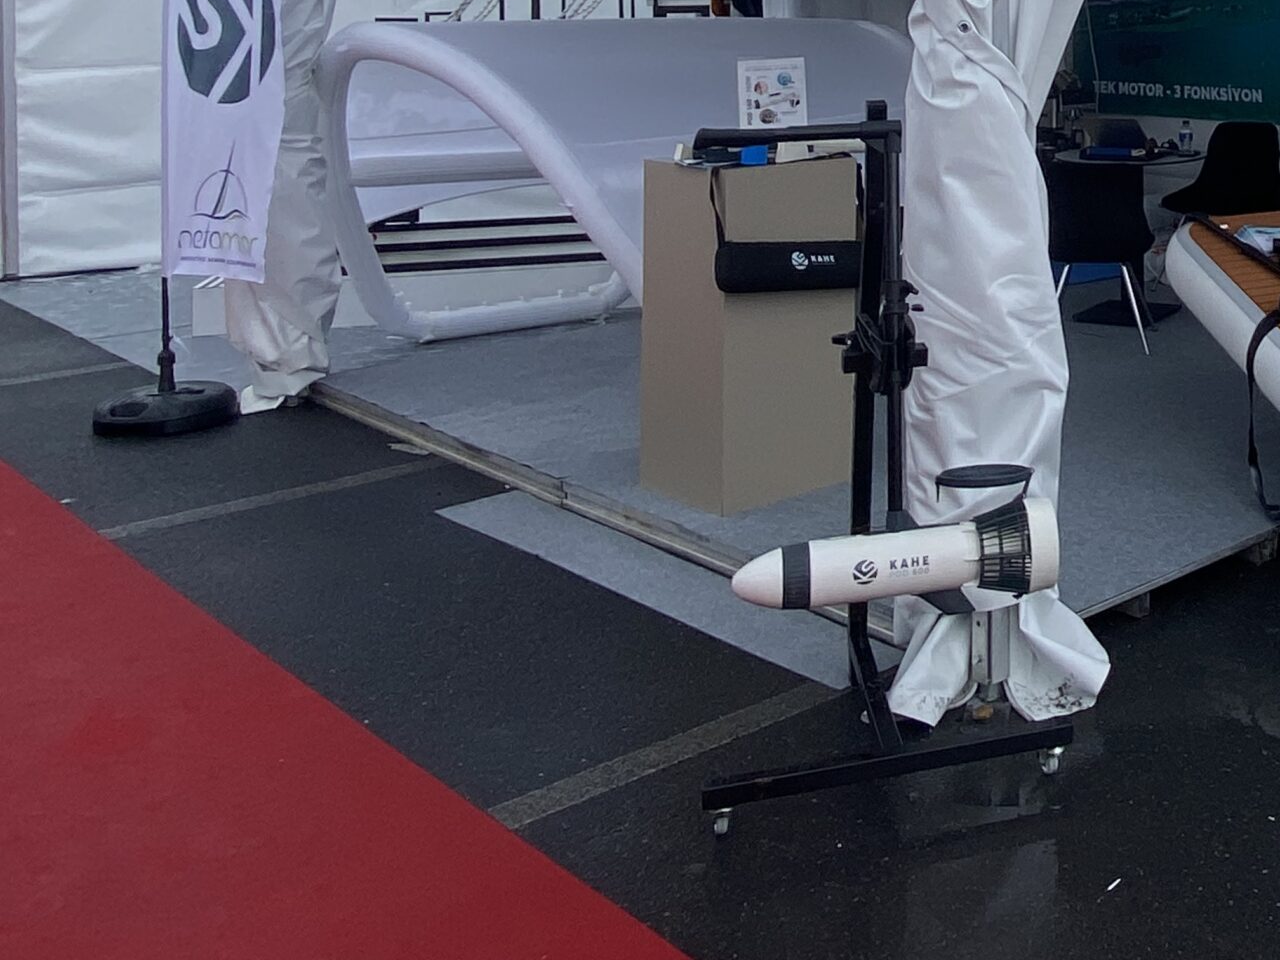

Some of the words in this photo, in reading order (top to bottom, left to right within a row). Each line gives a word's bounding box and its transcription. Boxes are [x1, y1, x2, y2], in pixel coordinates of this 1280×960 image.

[1118, 82, 1163, 97] MOTOR
[1174, 85, 1181, 98] 3
[1184, 84, 1263, 103] FONKSİYON
[889, 555, 930, 570] KAHE
